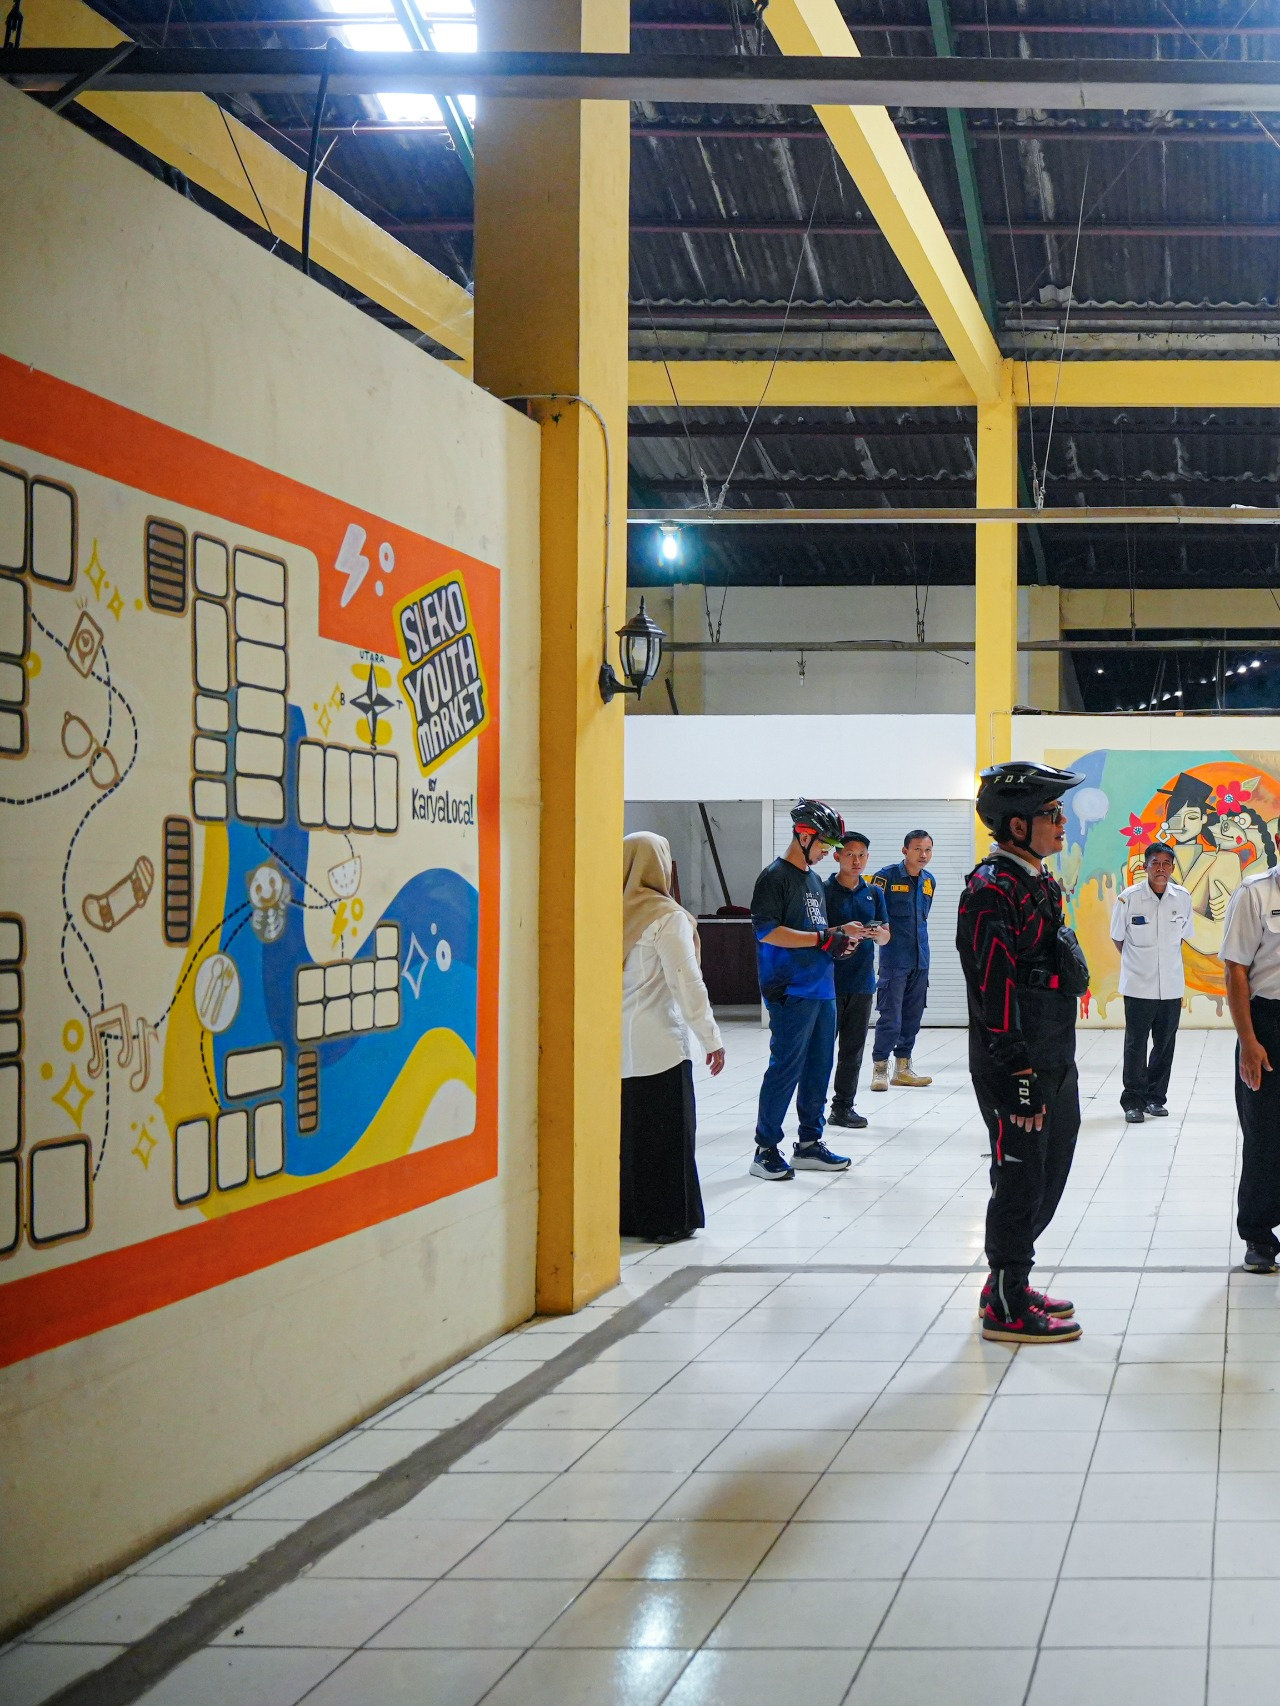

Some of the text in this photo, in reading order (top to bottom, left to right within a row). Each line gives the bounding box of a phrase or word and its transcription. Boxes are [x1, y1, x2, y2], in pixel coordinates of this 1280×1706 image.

[401, 583, 467, 664] SLEKO
[360, 650, 386, 663] UTARA
[403, 635, 479, 722] YOUTH
[396, 699, 404, 710] T
[416, 678, 483, 766] MARKET
[993, 774, 1027, 784] FOX
[1018, 1079, 1031, 1106] FOX
